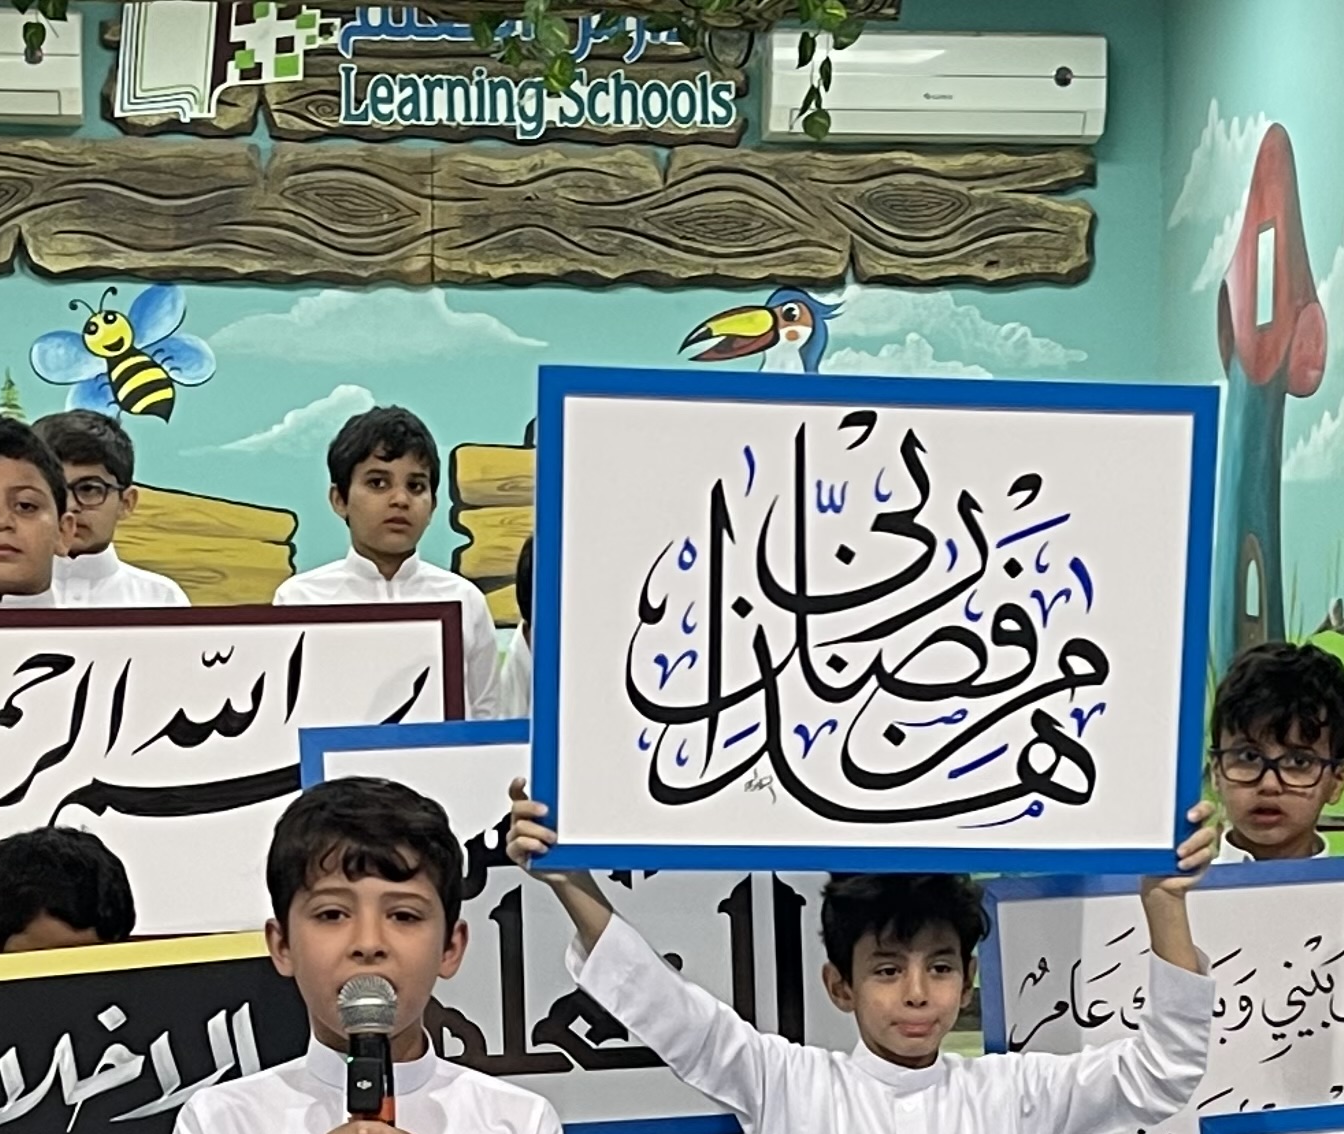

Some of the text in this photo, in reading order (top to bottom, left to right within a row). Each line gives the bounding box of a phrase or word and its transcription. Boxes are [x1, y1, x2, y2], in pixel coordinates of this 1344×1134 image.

[340, 65, 737, 139] Learning Schools
[133, 631, 307, 756] الله
